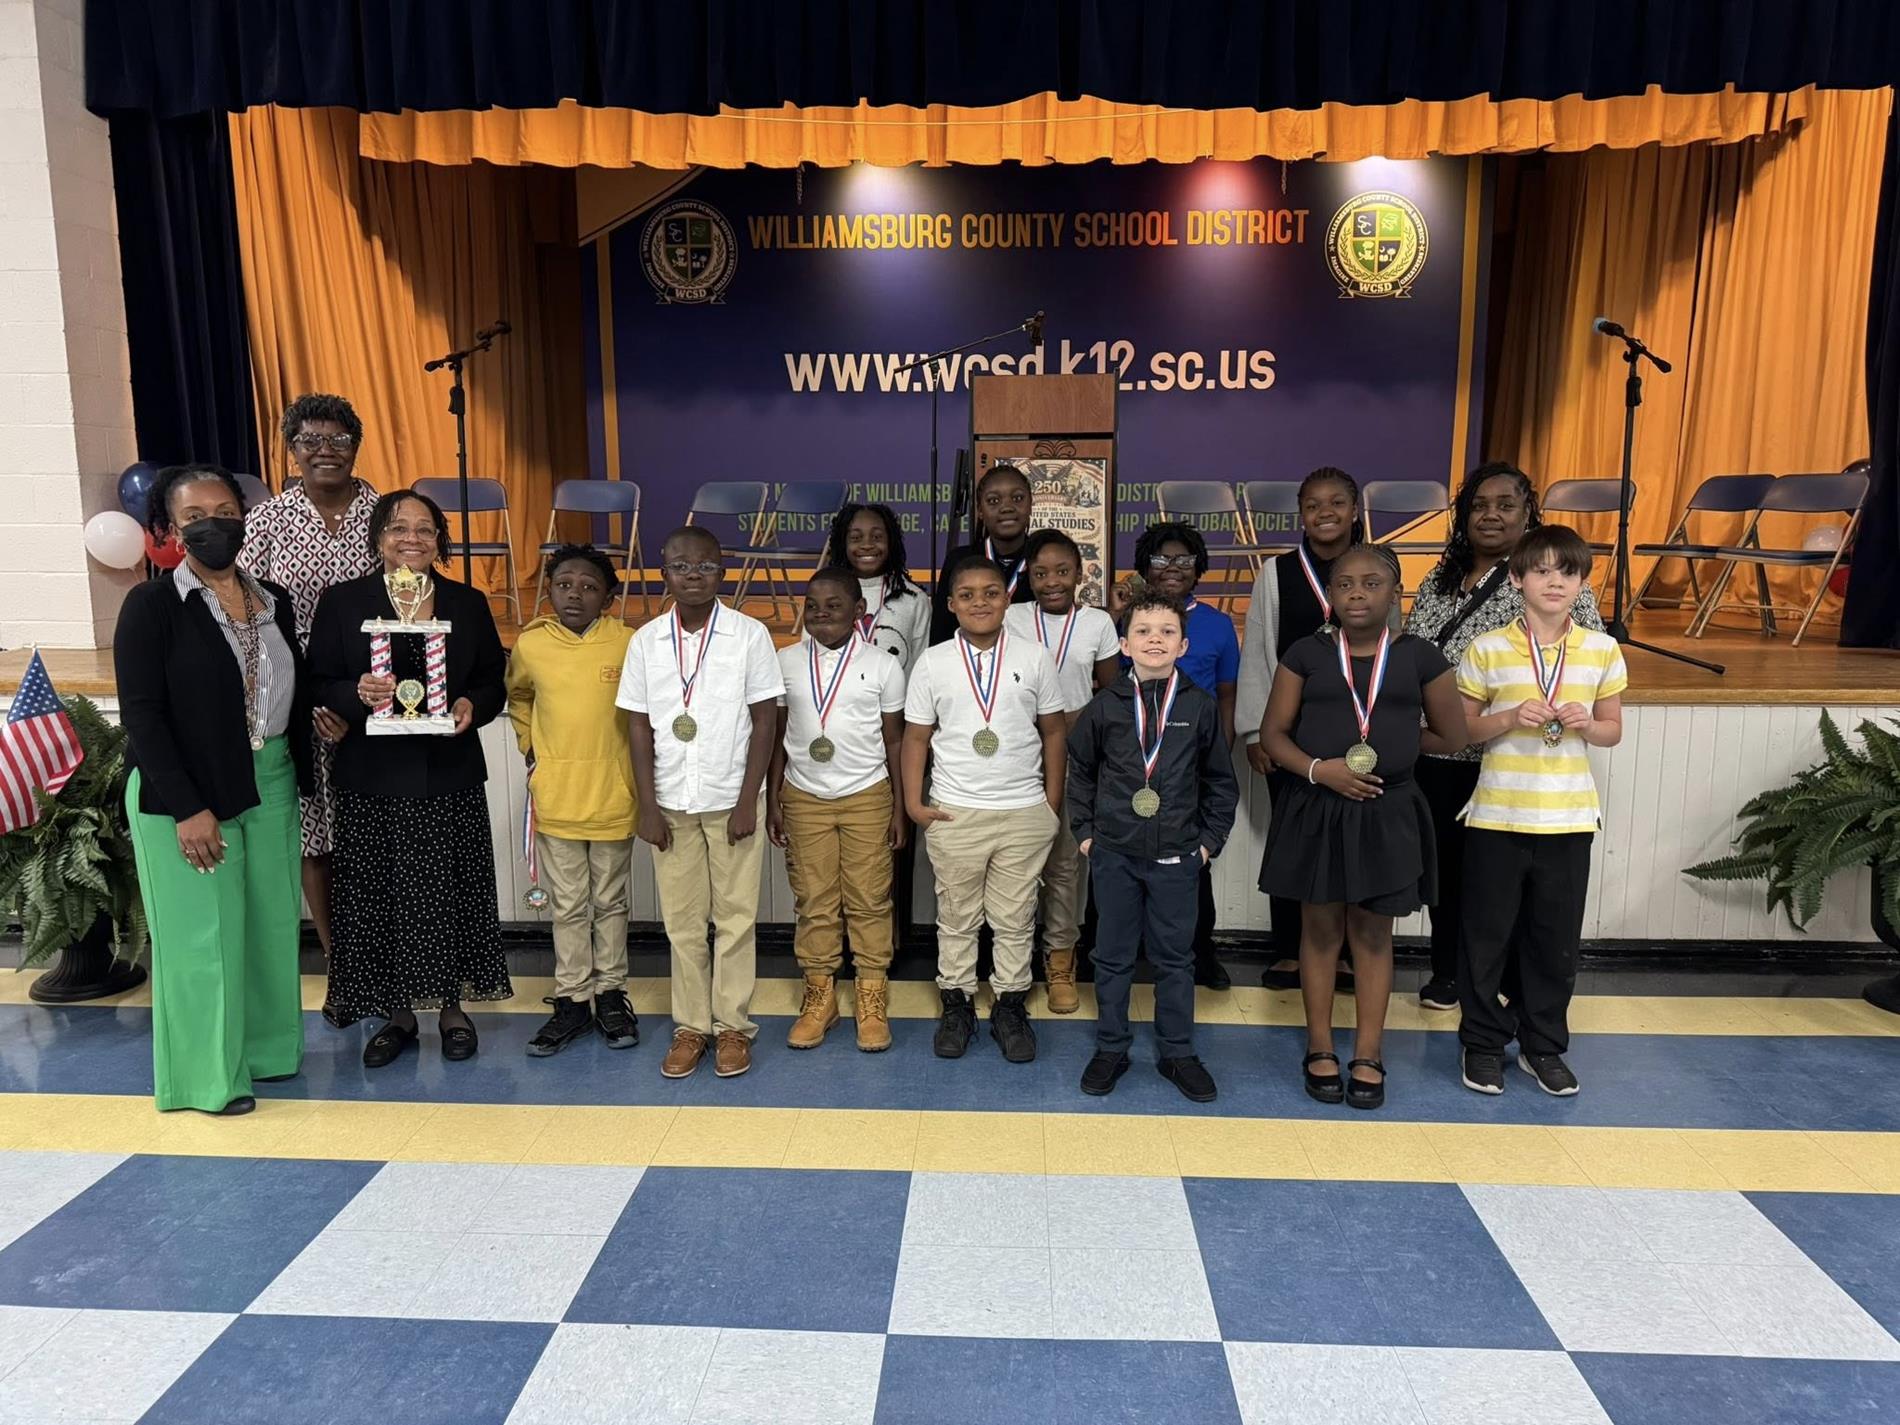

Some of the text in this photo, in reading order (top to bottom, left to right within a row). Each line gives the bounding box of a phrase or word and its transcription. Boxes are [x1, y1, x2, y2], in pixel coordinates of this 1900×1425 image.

[747, 208, 1310, 250] WILLIAMSBURG COUNTY SCHOOL DISTRICT
[674, 288, 707, 299] WCSD
[1358, 282, 1393, 294] WCSD
[784, 339, 1276, 393] www.wcsdk12.sc.us
[1034, 480, 1062, 494] 250
[1048, 518, 1096, 531] STUDIES
